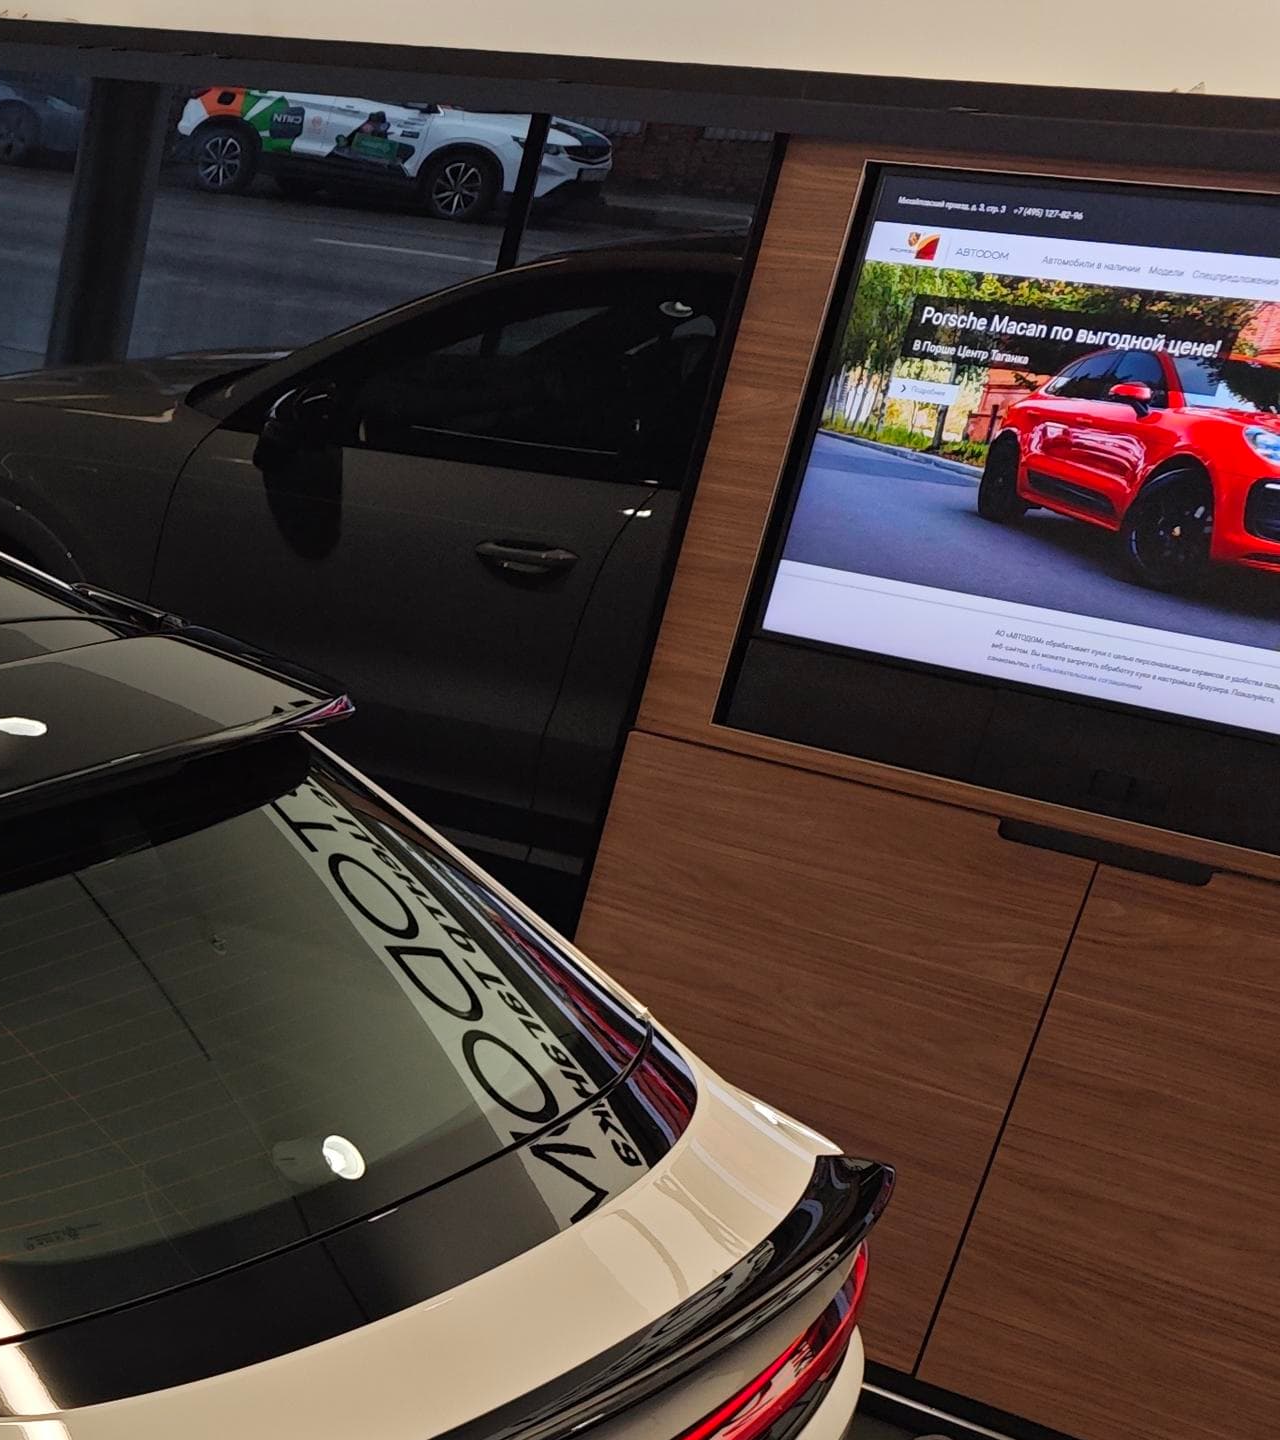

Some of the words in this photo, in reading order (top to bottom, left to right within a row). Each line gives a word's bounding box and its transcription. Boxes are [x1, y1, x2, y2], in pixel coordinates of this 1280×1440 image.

[1023, 206, 1043, 218] (495)
[1041, 255, 1096, 271] Автомобили
[1148, 265, 1185, 278] Модели
[920, 306, 987, 332] Porsche
[990, 314, 1046, 339] Macan
[1050, 325, 1074, 342] по
[1077, 327, 1167, 354] выгодной
[1168, 339, 1224, 361] цене!
[912, 339, 920, 351] В
[922, 341, 956, 357] Порше
[957, 344, 989, 363] Центр
[991, 350, 1029, 366] Таганка
[994, 629, 1006, 638] АО
